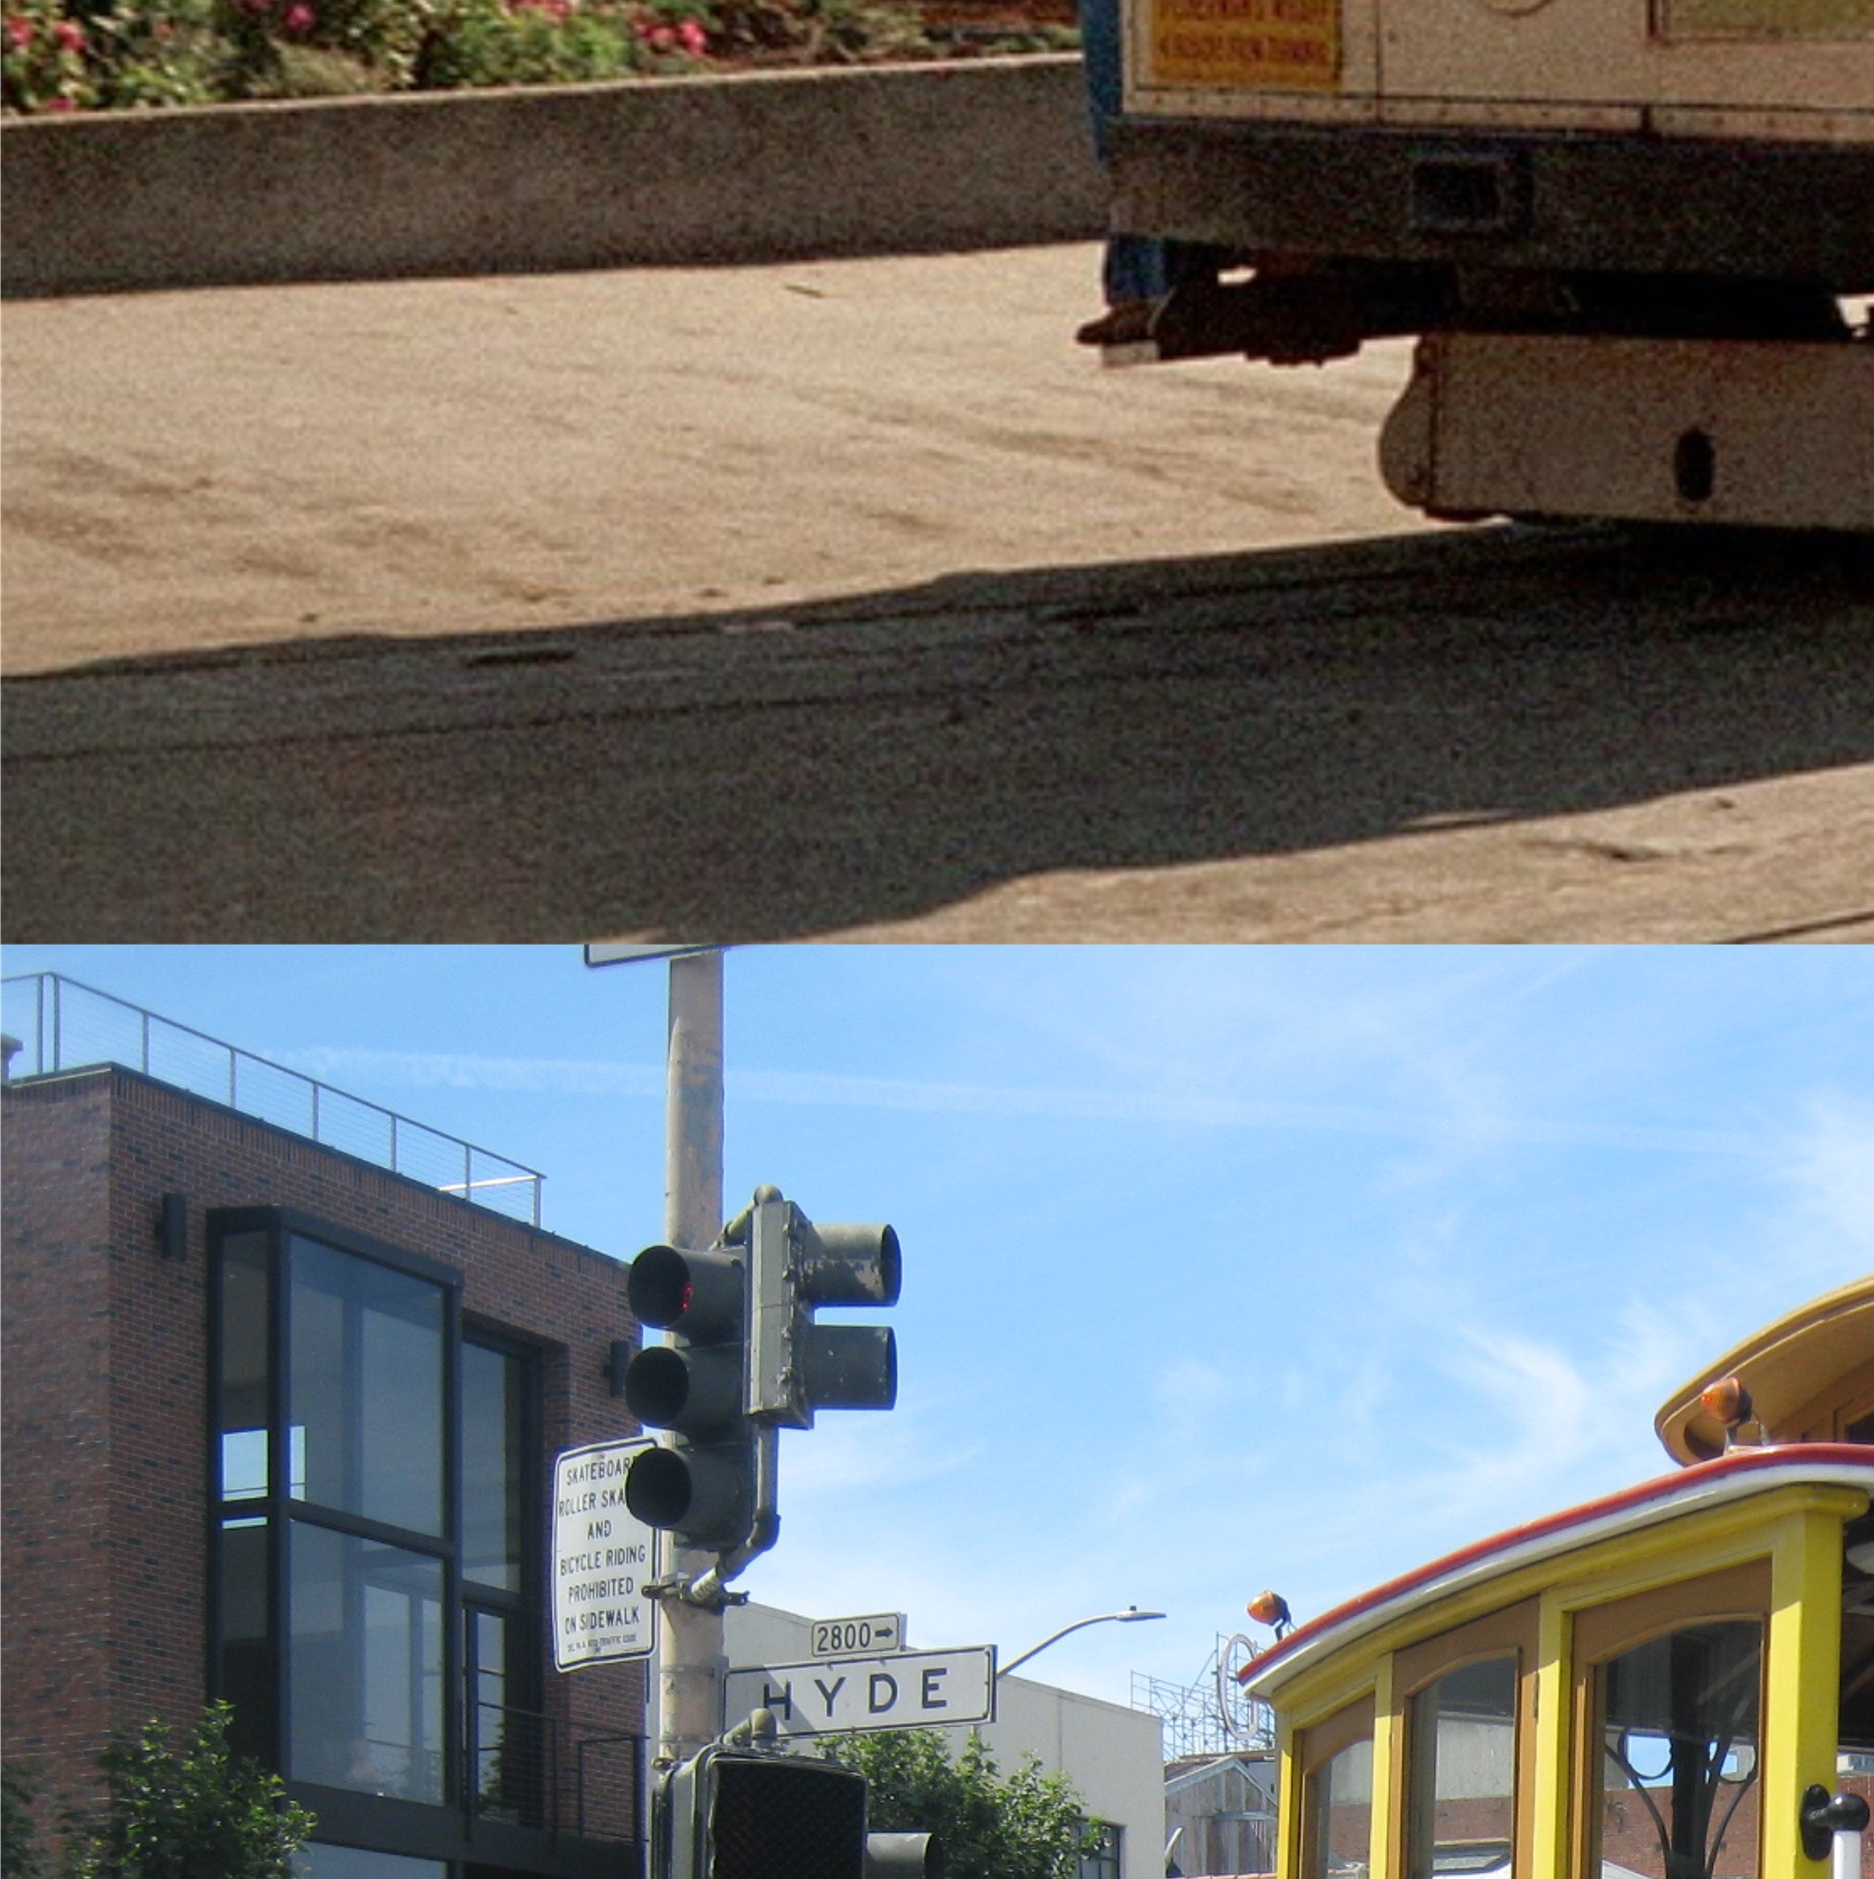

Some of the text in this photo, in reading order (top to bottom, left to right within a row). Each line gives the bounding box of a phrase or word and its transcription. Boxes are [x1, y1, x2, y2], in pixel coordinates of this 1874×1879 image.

[567, 1457, 632, 1485] SKATEBOAR
[559, 1488, 626, 1517] ROLLER SKA
[587, 1520, 612, 1540] AND
[560, 1545, 646, 1576] BICYCLE RIDING
[568, 1577, 634, 1604] PROHIBITED
[565, 1606, 640, 1635] ON SIDEWALK
[816, 1619, 873, 1649] 2800
[763, 1667, 949, 1720] HYDE
